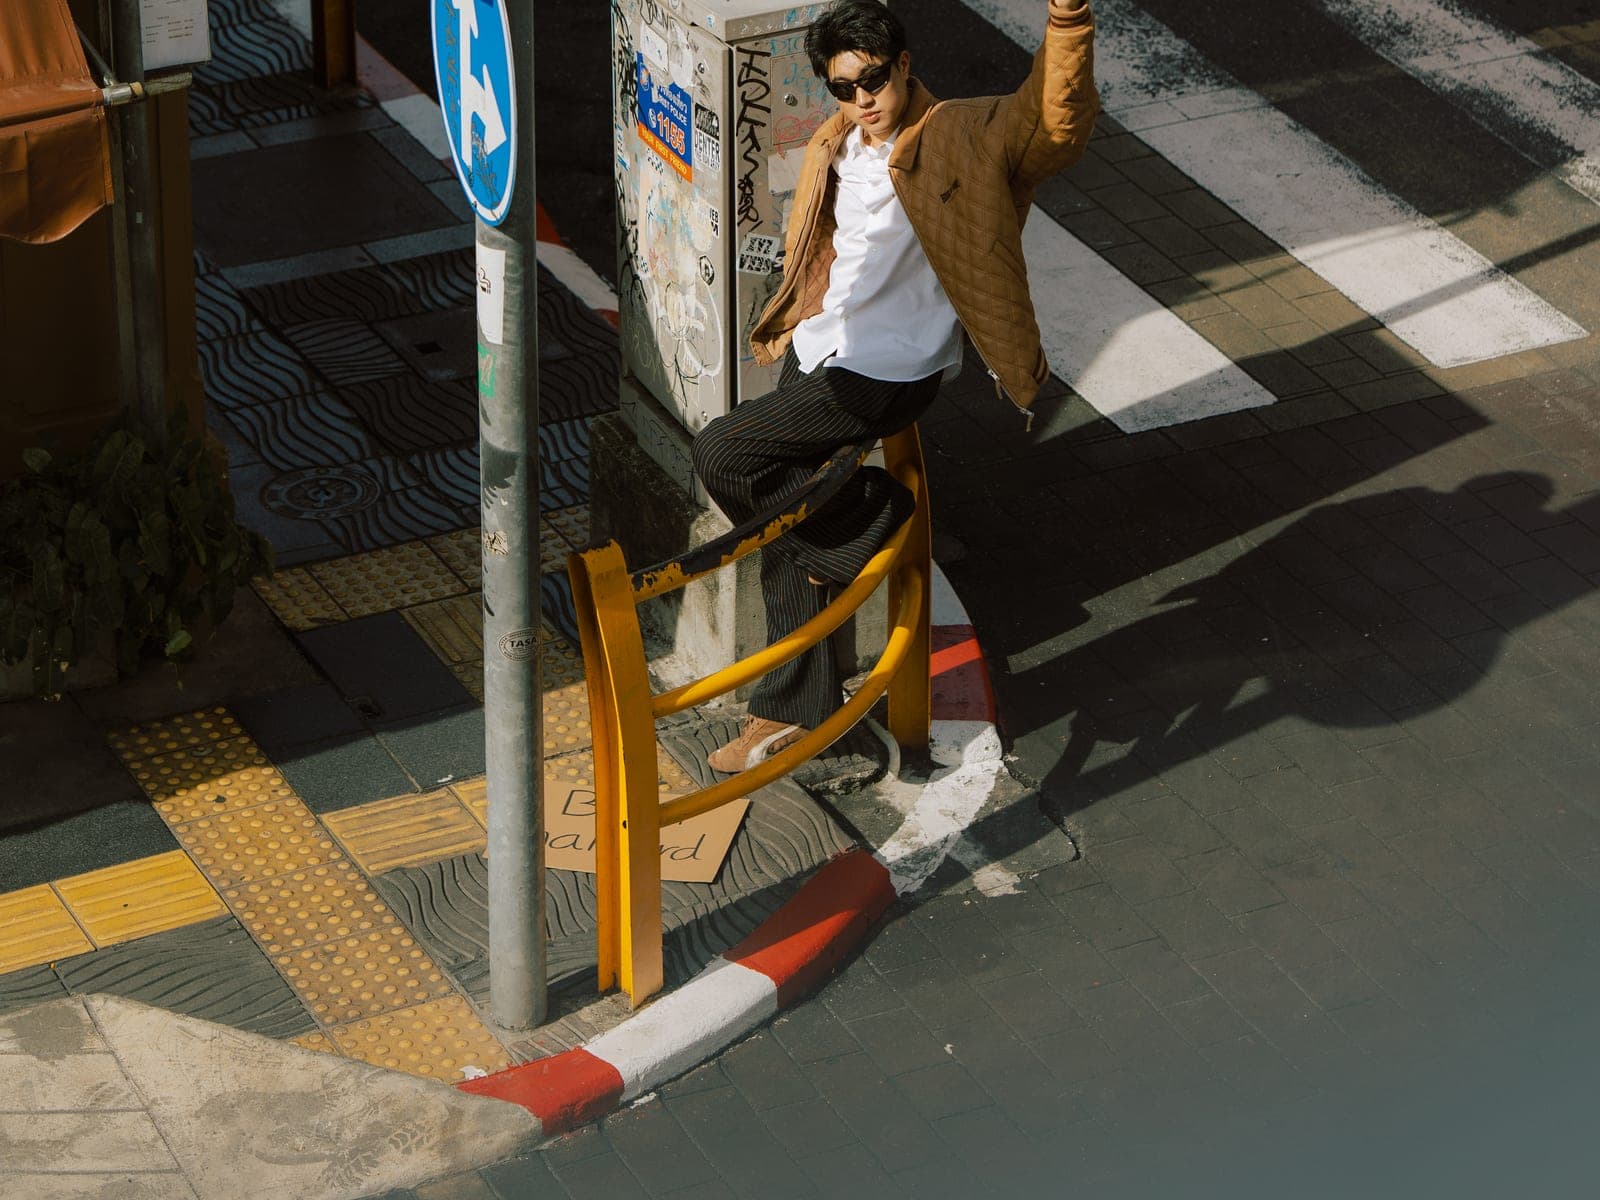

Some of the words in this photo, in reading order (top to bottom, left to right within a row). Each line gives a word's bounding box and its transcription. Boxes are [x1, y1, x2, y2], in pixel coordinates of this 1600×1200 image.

[657, 111, 686, 155] 1155
[670, 106, 688, 127] POLICE
[642, 126, 654, 144] YOUR
[656, 140, 668, 158] FIRST
[669, 152, 688, 175] FRIEND
